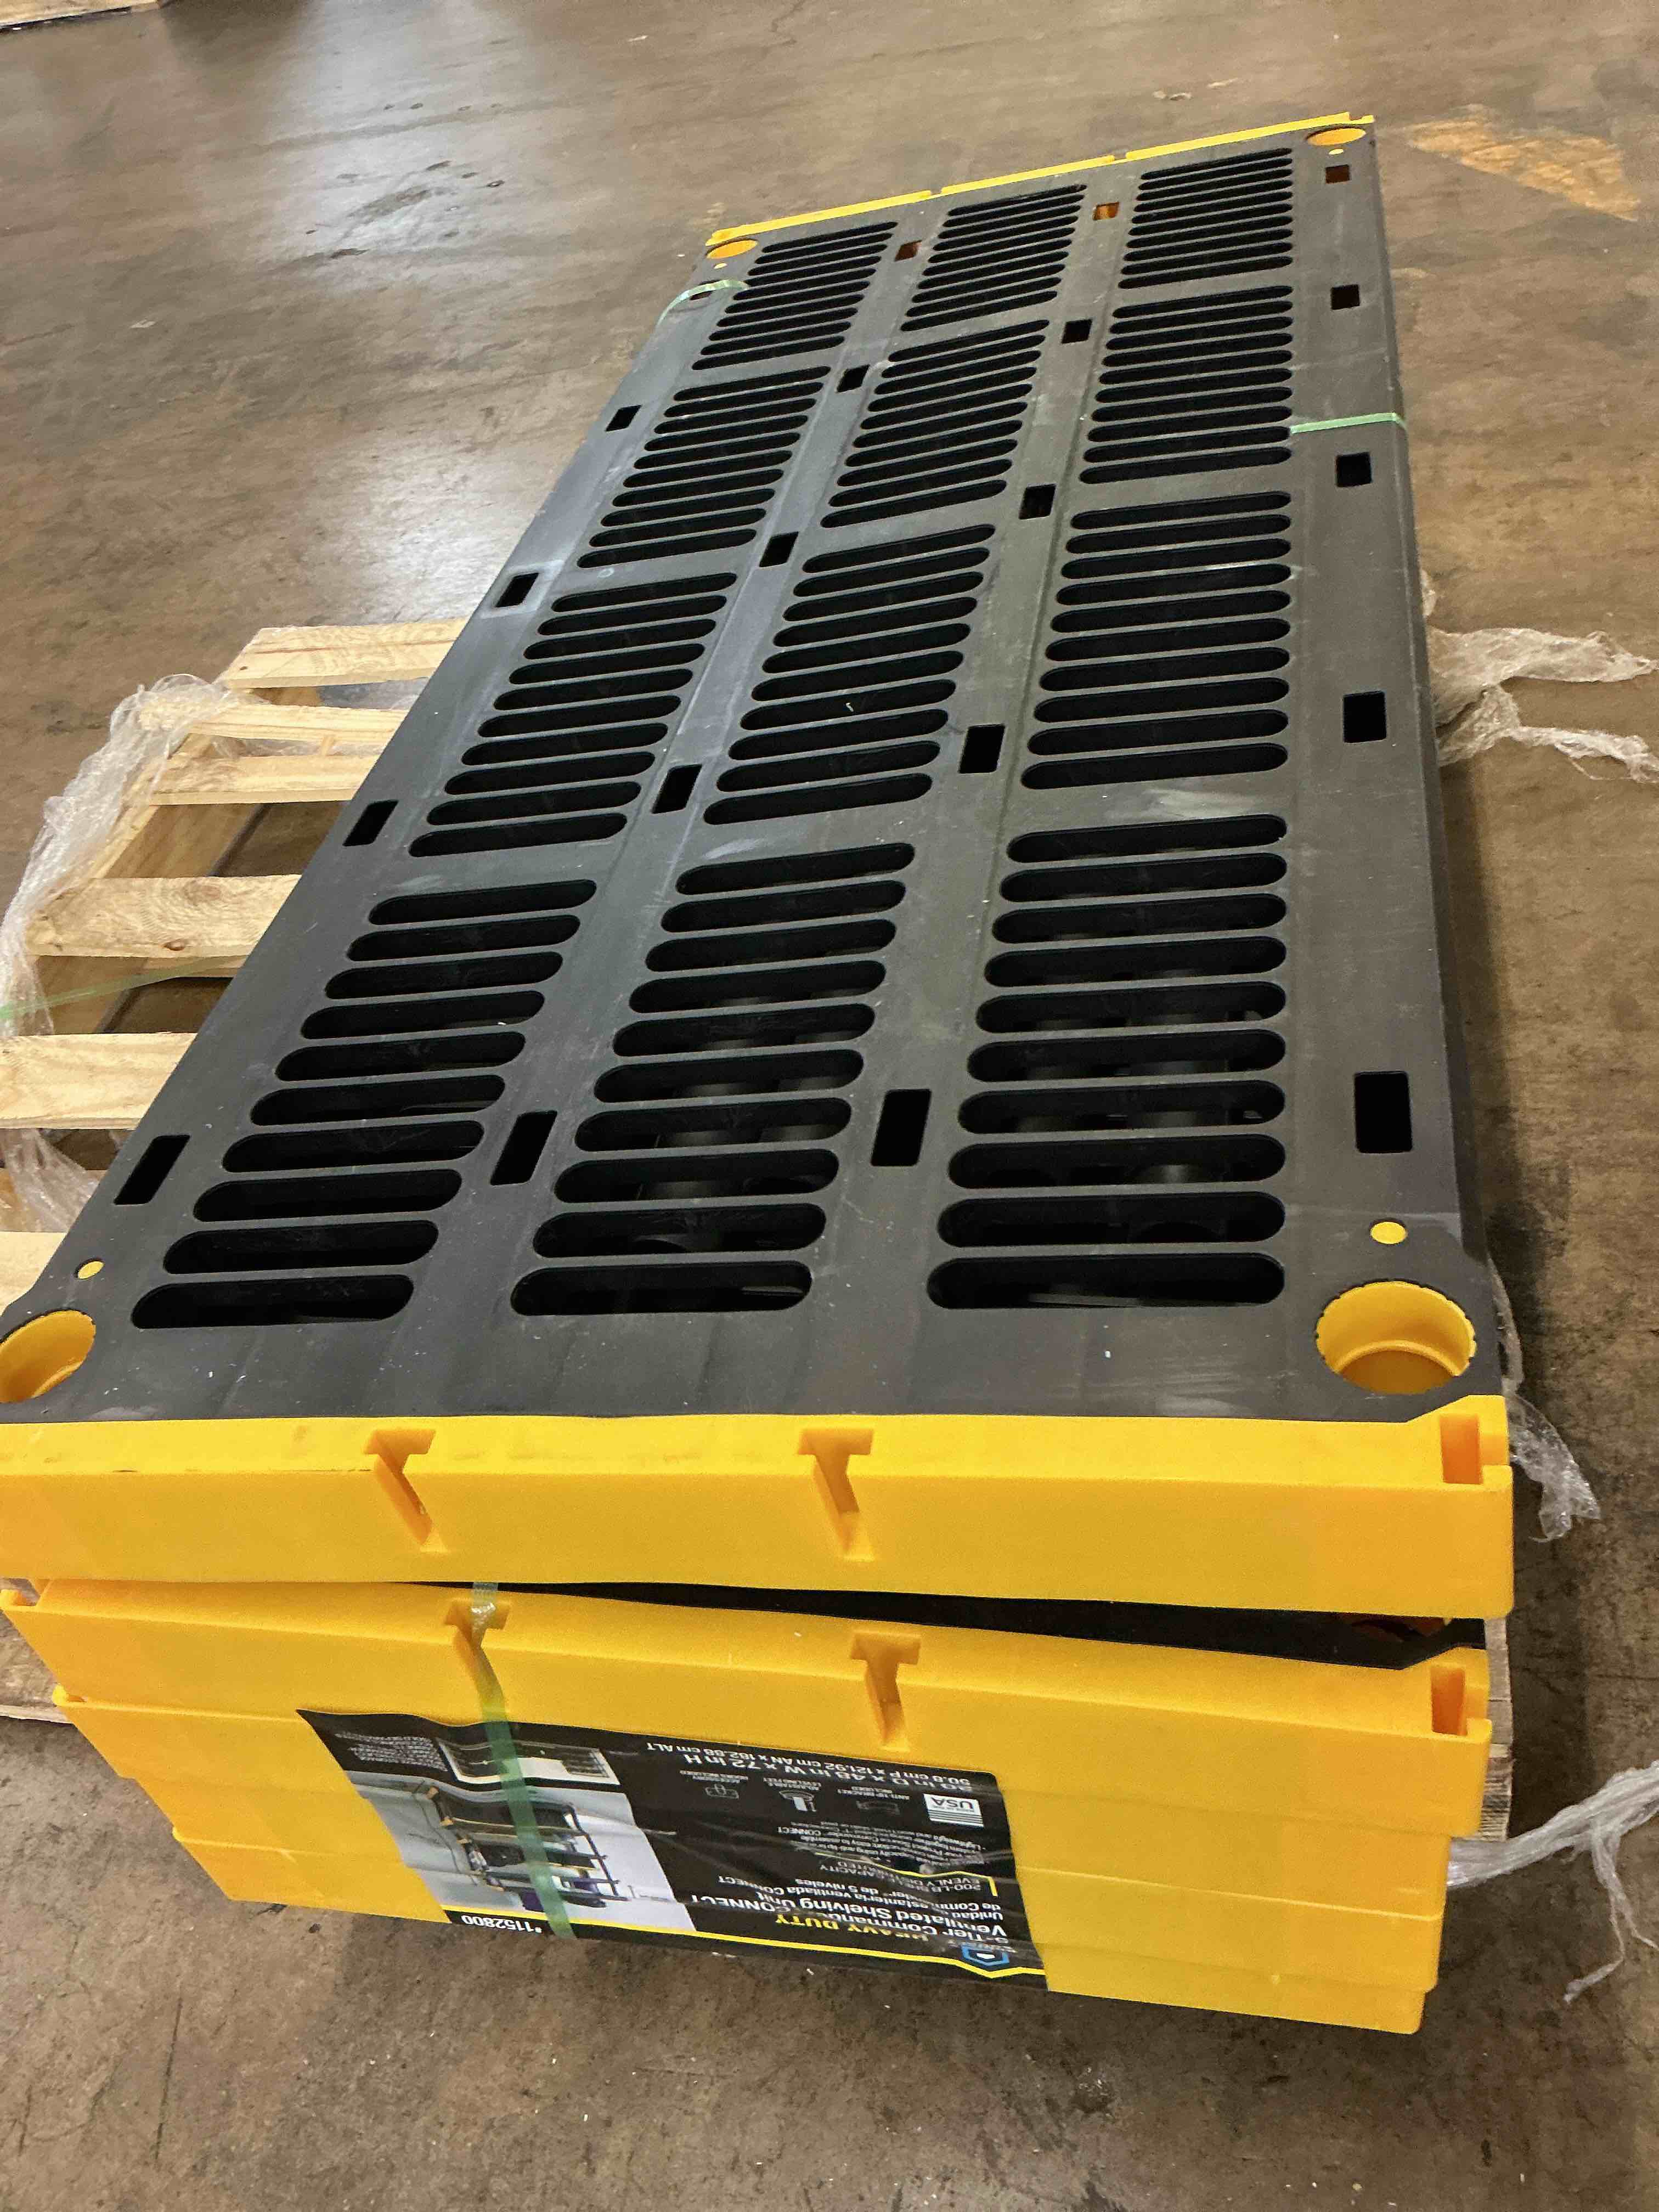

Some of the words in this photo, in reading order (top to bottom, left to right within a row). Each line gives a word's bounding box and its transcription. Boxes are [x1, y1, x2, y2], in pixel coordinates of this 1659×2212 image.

[646, 1742, 674, 1752] ALT
[683, 1754, 703, 1765] H
[704, 1755, 727, 1766] in
[727, 1757, 761, 1769] 72
[770, 1756, 793, 1765] AN
[796, 1759, 821, 1767] cm
[784, 1765, 808, 1775] W
[809, 1768, 831, 1778] in
[904, 1771, 930, 1779] cm
[835, 1771, 865, 1780] 48
[932, 1775, 971, 1786] 50.8
[891, 1778, 910, 1786] D
[913, 1780, 936, 1788] in
[930, 1797, 973, 1809] USA
[794, 1878, 845, 1892] niveles
[848, 1885, 859, 1894] 5
[786, 1886, 851, 1898] ventilada
[860, 1887, 878, 1895] de
[755, 1892, 795, 1908] Unit
[799, 1898, 891, 1919] Shelving
[982, 1903, 1001, 1911] de
[775, 1914, 839, 1930] DUTY
[895, 1910, 1007, 1937] Ventilated
